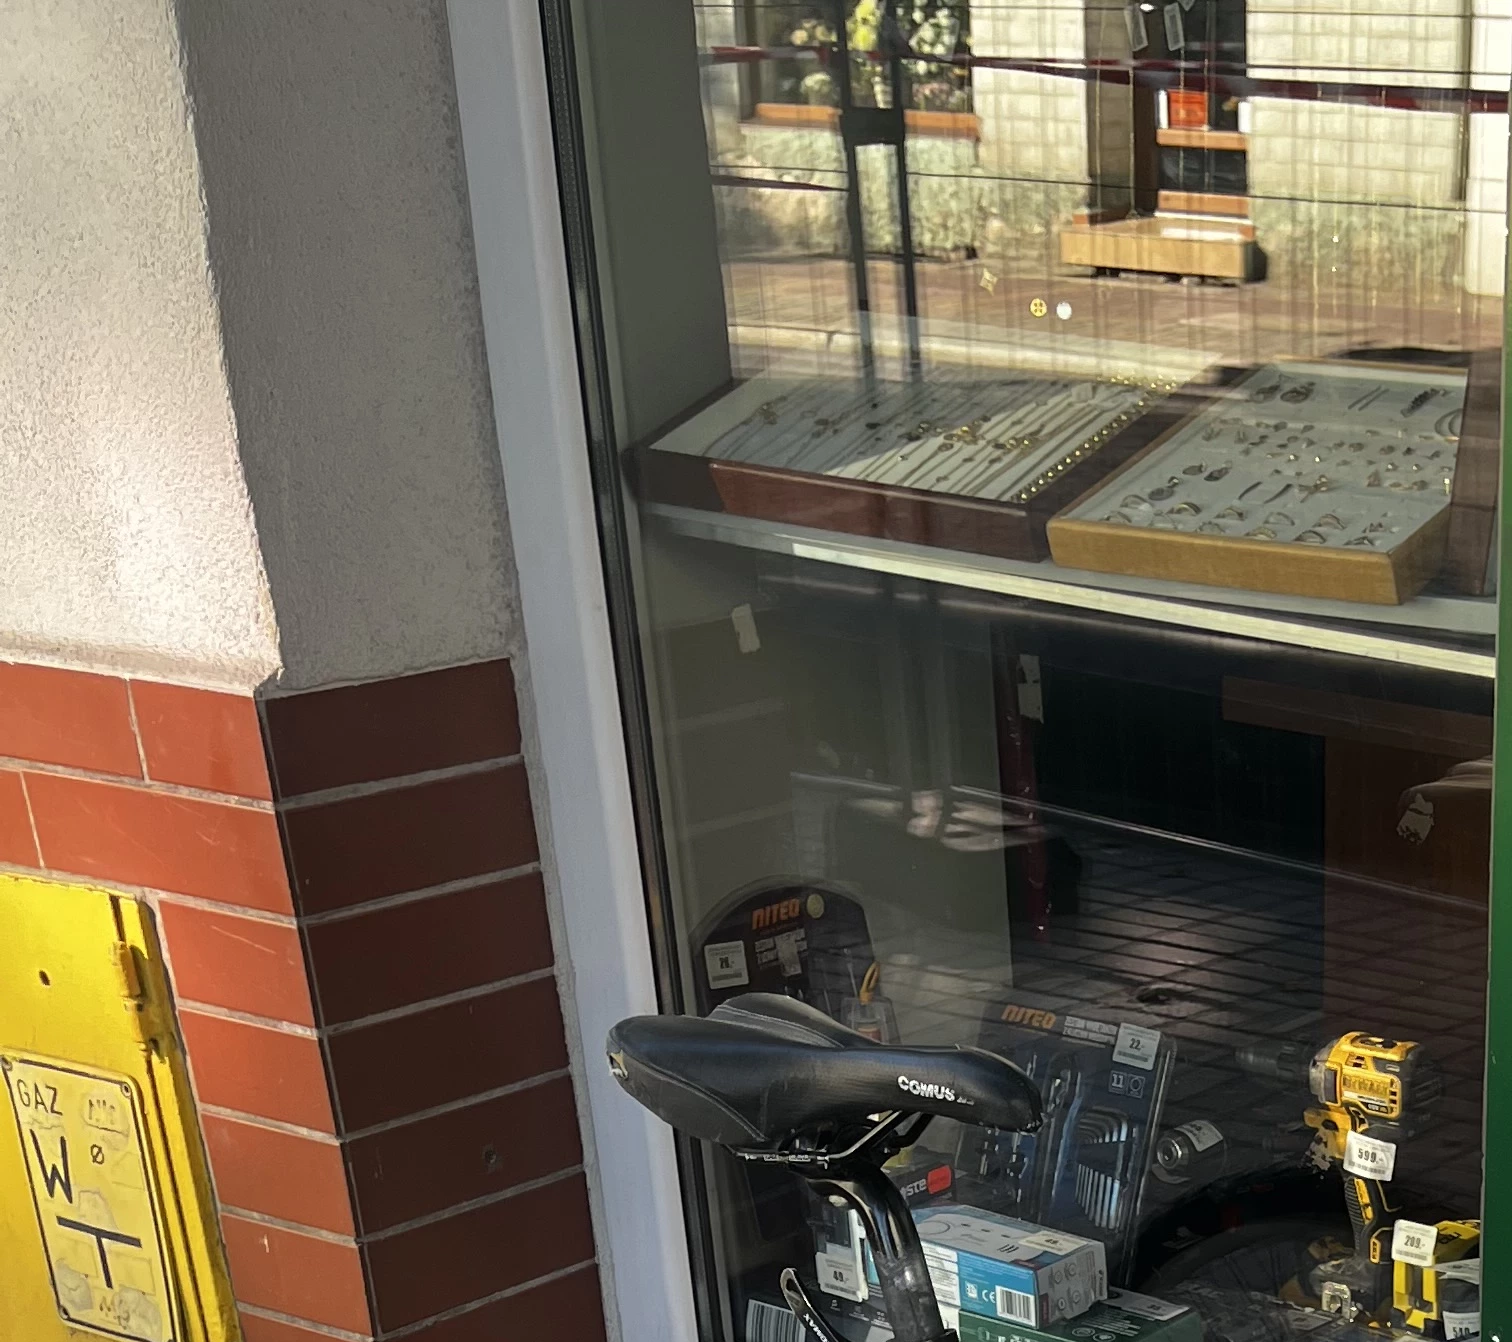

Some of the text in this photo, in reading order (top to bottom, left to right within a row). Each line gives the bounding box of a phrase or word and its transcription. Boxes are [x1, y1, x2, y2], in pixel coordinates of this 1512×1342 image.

[16, 1079, 63, 1116] GAZ
[897, 1075, 956, 1101] COMUS
[29, 1128, 73, 1204] W
